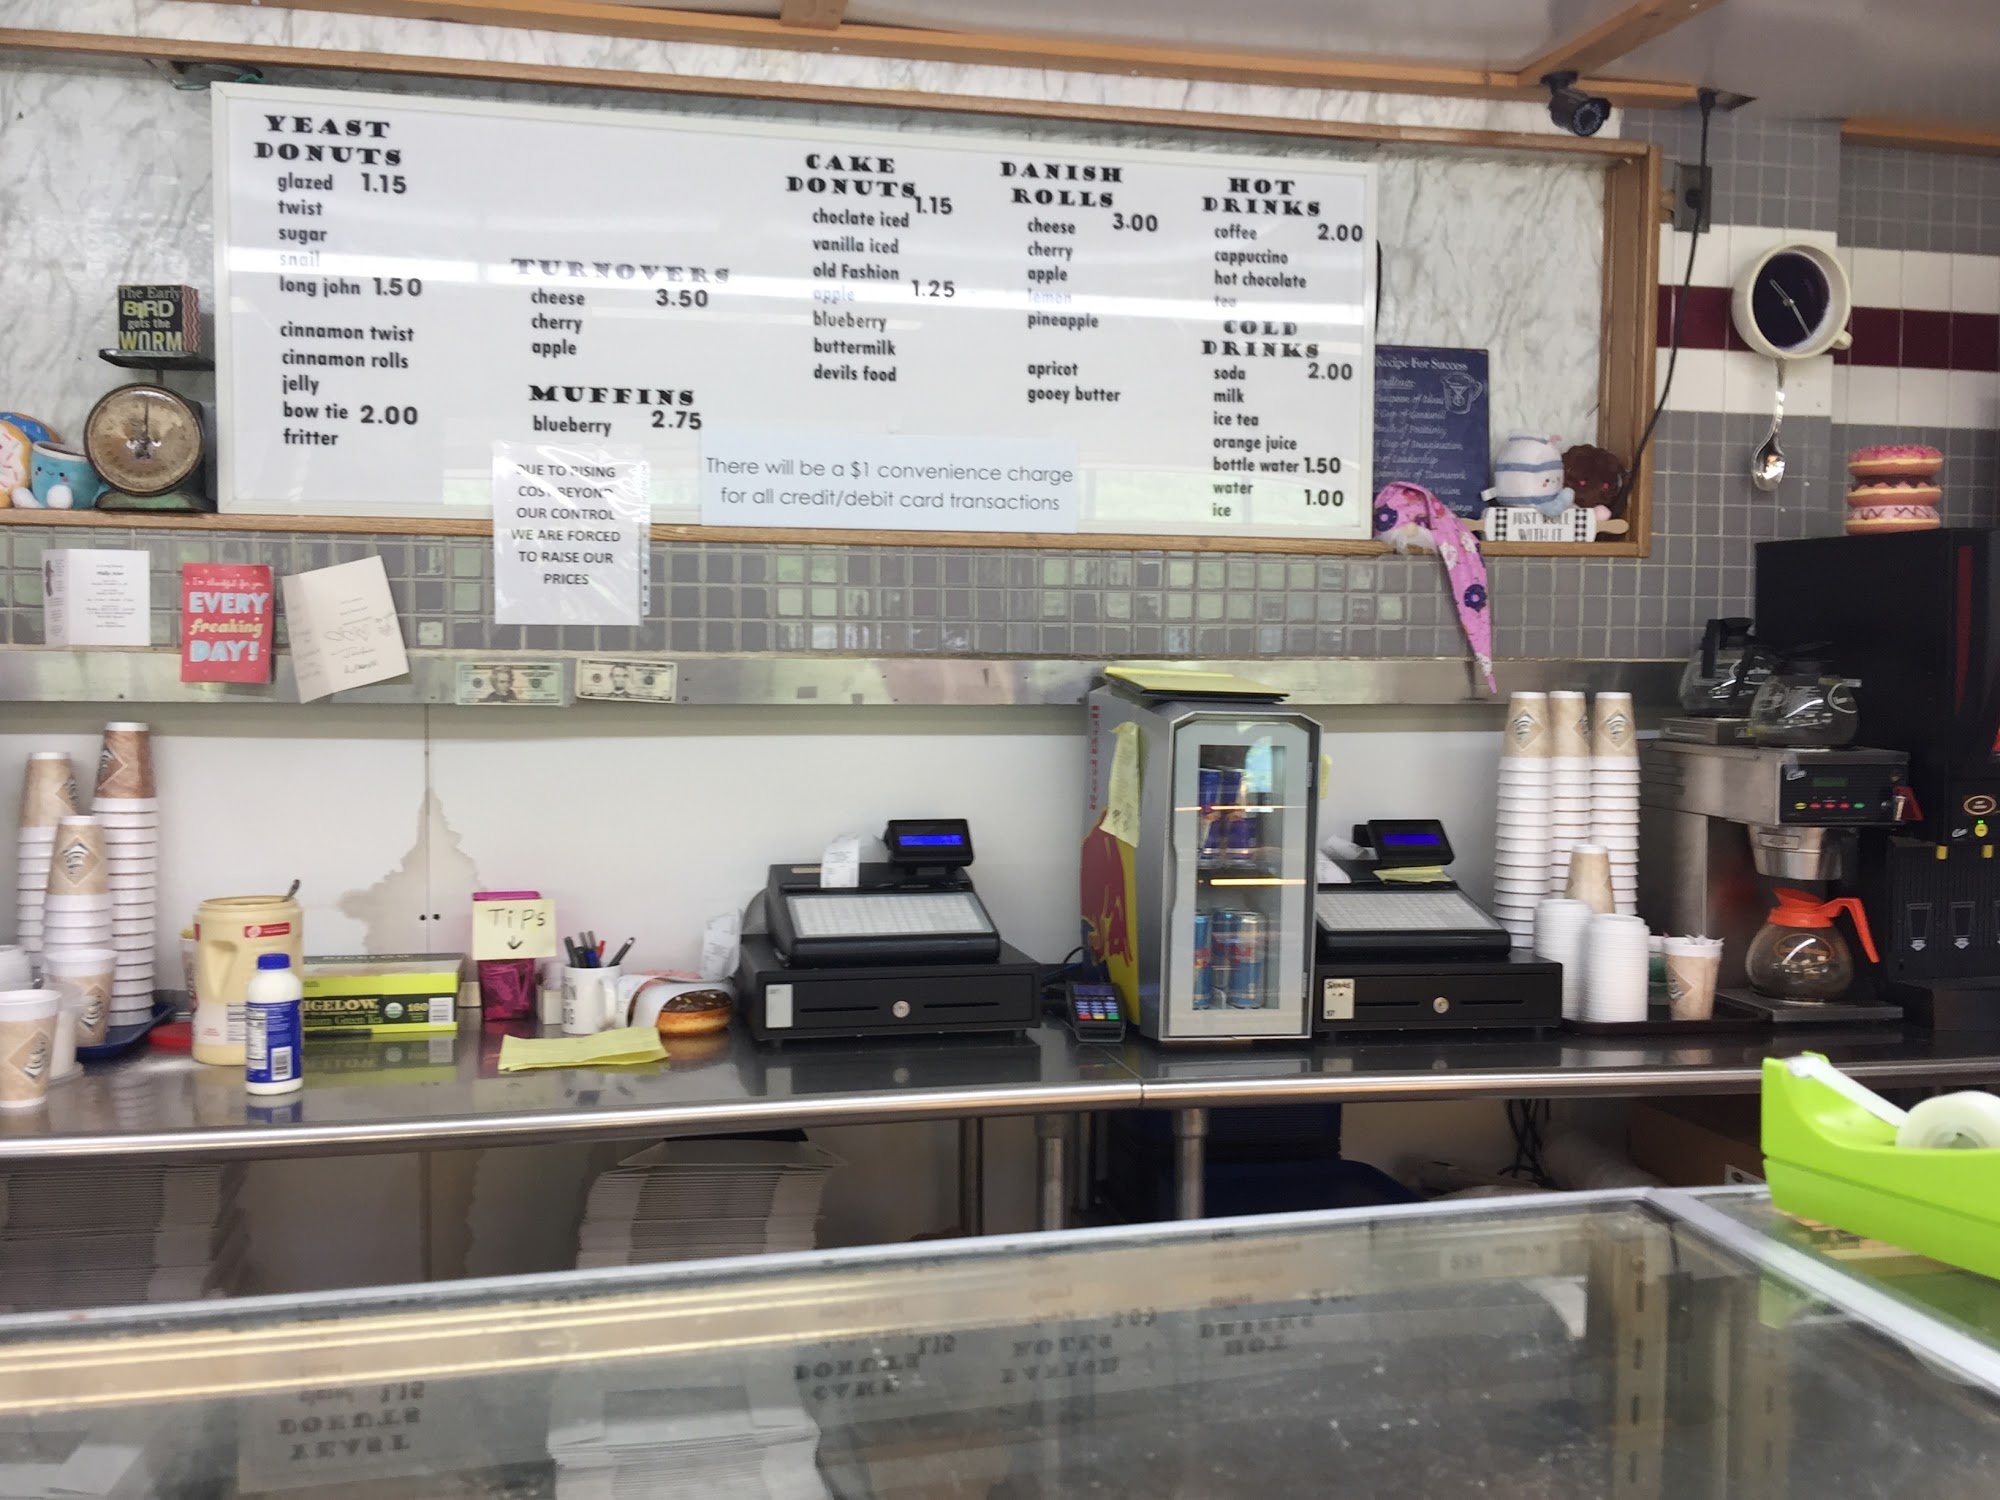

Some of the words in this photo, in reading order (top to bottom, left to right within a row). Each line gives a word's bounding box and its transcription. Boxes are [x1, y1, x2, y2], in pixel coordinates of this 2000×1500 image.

[264, 114, 390, 139] YEAST
[254, 141, 402, 167] DONUTS
[805, 153, 895, 174] CAKE
[1000, 161, 1122, 183] DANISH
[277, 171, 334, 193] glazed
[361, 172, 407, 195] 1.15
[787, 176, 917, 198] DONUTS
[1229, 177, 1296, 196] HOT
[277, 198, 323, 216] twist
[1011, 187, 1114, 208] ROLLS
[1202, 196, 1321, 217] DRINKS
[812, 207, 875, 227] choclate
[880, 211, 910, 228] iced
[914, 195, 954, 216] 1.15
[1027, 216, 1076, 235] cheese
[1112, 212, 1159, 233] 3.00
[1214, 223, 1257, 241] coffee
[1317, 222, 1364, 243] 2.00
[278, 228, 328, 246] sugar
[812, 236, 865, 253] vanilla
[869, 237, 899, 254] iced
[279, 250, 321, 266] snail
[1027, 240, 1073, 262] cherry
[1214, 248, 1289, 267] cappuccino
[510, 257, 731, 282] TURNOVERS
[812, 261, 837, 279] old
[841, 263, 900, 281] Fashion
[1027, 265, 1068, 285] apple
[1214, 269, 1238, 286] hot
[1242, 270, 1307, 289] chocolate
[121, 287, 143, 298] The
[147, 287, 180, 301] Early
[279, 275, 317, 298] long
[323, 277, 361, 299] john
[372, 276, 423, 298] 1.50
[813, 287, 855, 305] apple
[910, 278, 955, 298] 1.25
[530, 287, 585, 306] cheese
[655, 288, 709, 309] 3.50
[1213, 294, 1238, 307] tea
[123, 300, 174, 318] BIRD
[128, 320, 150, 330] gets
[152, 319, 170, 328] the
[280, 320, 364, 340] cinnamon
[369, 325, 415, 342] twist
[531, 312, 583, 335] cherry
[812, 309, 887, 333] blueberry
[1027, 311, 1099, 332] pineapple
[1222, 320, 1298, 337] COLD
[531, 338, 577, 359] apple
[813, 336, 896, 356] buttermilk
[1202, 340, 1319, 359] DRINKS
[281, 348, 366, 368] cinnamon
[371, 351, 409, 369] rolls
[813, 363, 858, 381] devils
[862, 365, 897, 382] food
[1027, 360, 1079, 379] apricot
[1213, 364, 1246, 381] soda
[1307, 361, 1353, 381] 2.00
[282, 374, 320, 396] jelly
[1027, 388, 1071, 405] gooey
[1075, 385, 1121, 402] butter
[1213, 387, 1245, 403] milk
[528, 384, 694, 407] MUFFINS
[283, 400, 319, 419] bow
[324, 403, 349, 420] tie
[360, 404, 419, 426] 2.00
[1213, 410, 1232, 426] ice
[1236, 413, 1259, 427] tea
[532, 414, 612, 438] blueberry
[651, 409, 703, 431] 2.75
[282, 427, 339, 446] fritter
[1213, 437, 1262, 453] orange
[1265, 434, 1298, 454] juice
[547, 464, 567, 477] TO
[706, 457, 760, 475] There
[764, 460, 794, 475] will
[799, 460, 826, 477] be
[831, 464, 845, 477] a
[850, 460, 869, 479] $1
[877, 463, 1002, 481] convenience
[1007, 466, 1074, 486] charge
[1212, 455, 1256, 472] bottle
[1259, 459, 1300, 473] water
[1303, 456, 1342, 475] 1.50
[517, 485, 551, 498] COS
[720, 486, 747, 504] for
[752, 489, 774, 505] all
[779, 489, 894, 508] credit/debit
[899, 493, 944, 509] card
[949, 493, 1060, 511] transactions
[1212, 481, 1254, 495] water
[1304, 488, 1345, 507] 1.00
[516, 507, 548, 519] OUR
[550, 507, 616, 521] CONTROL
[1212, 502, 1232, 517] ice
[1513, 512, 1536, 524] JUST
[511, 528, 534, 541] WE
[537, 529, 564, 542] ARE
[567, 530, 621, 543] FORCED
[518, 550, 538, 563] TO
[541, 551, 580, 564] RAISE
[582, 552, 614, 564] OUR
[543, 573, 589, 585] PRICES
[189, 592, 269, 614] EVERY
[189, 618, 264, 638] freaking
[190, 640, 259, 662] DAY!
[303, 999, 379, 1011] IGELOW
